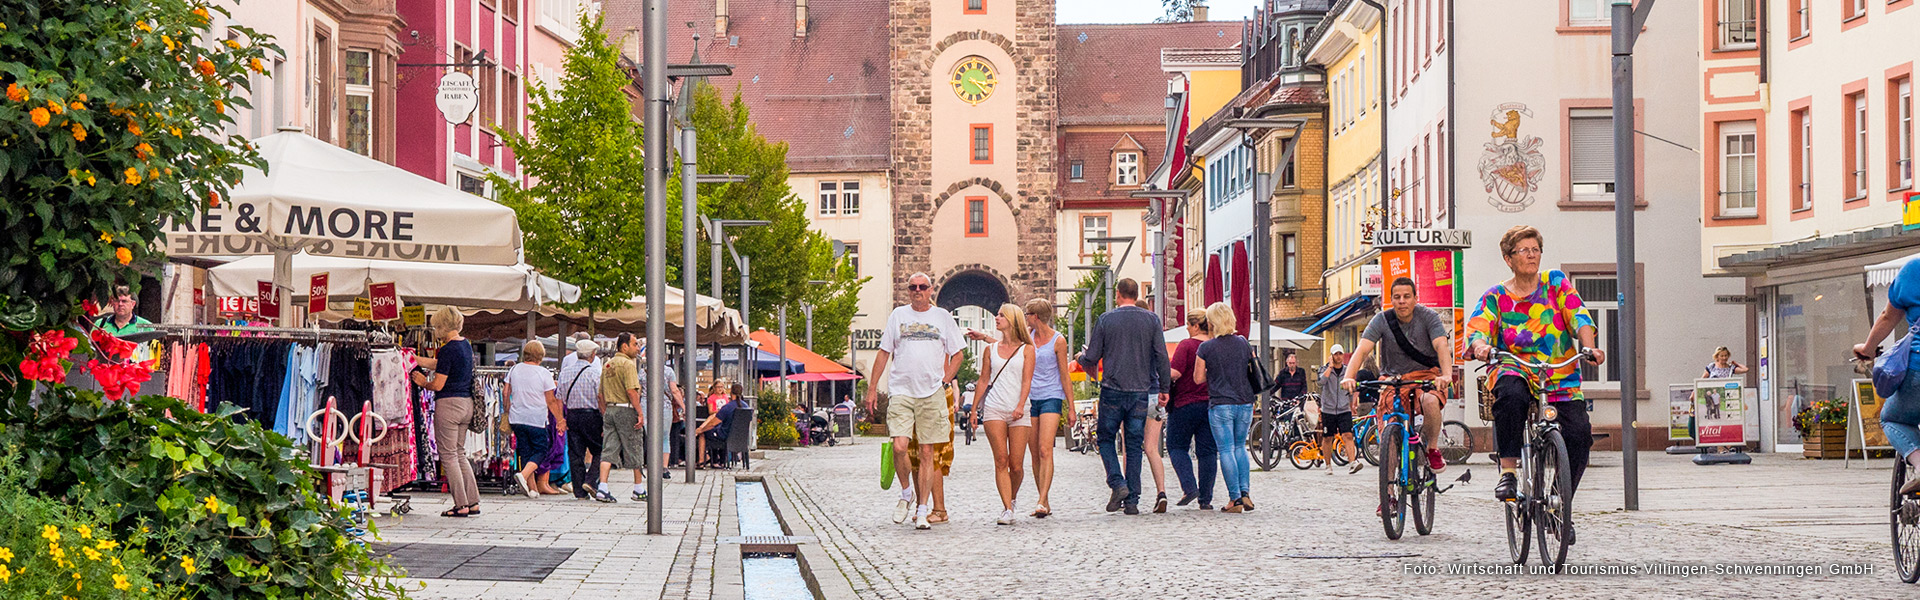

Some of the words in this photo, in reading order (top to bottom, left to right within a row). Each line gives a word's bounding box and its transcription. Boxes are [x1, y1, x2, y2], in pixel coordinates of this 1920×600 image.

[157, 203, 222, 232] RE
[235, 203, 262, 233] &
[284, 205, 414, 241] MORE
[312, 285, 327, 297] 50%
[221, 296, 240, 311] 1€
[242, 296, 258, 312] 1€
[373, 296, 395, 307] 50%
